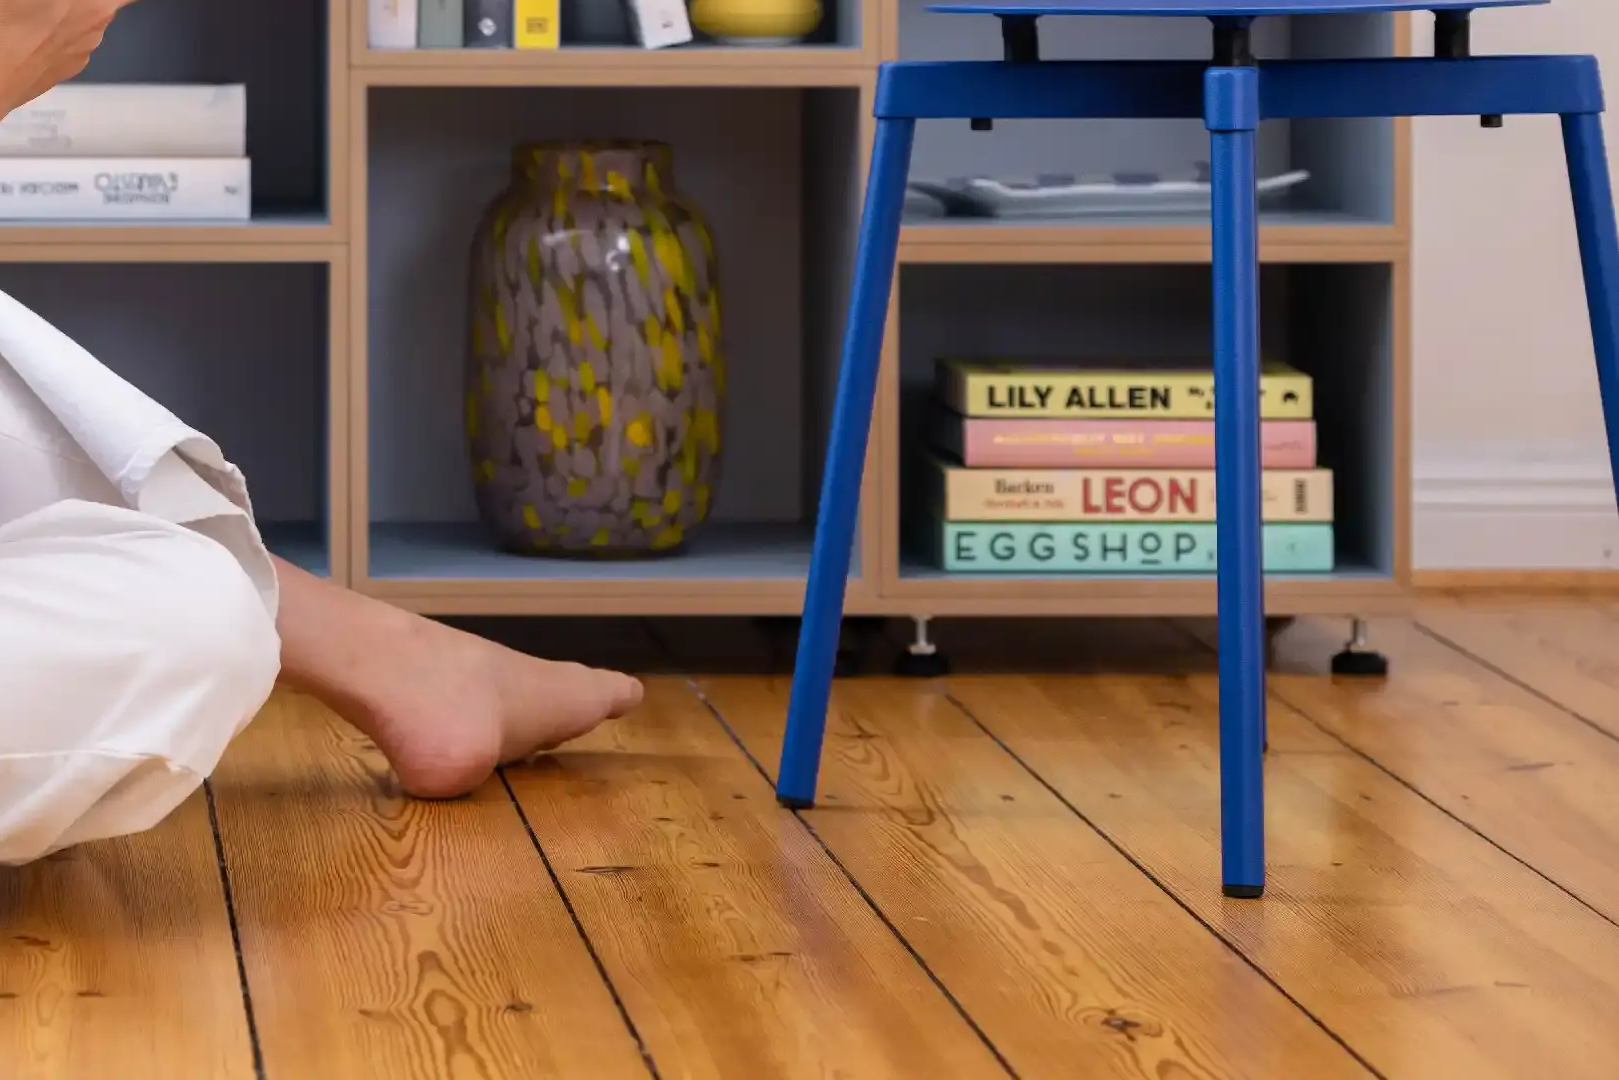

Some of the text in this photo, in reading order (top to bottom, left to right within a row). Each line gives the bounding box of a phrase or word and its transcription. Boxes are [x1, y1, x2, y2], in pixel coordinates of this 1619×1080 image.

[987, 385, 1052, 409] LILY
[1065, 385, 1171, 410] ALLEN
[1081, 477, 1198, 514] LEON
[955, 531, 1197, 564] EGG SHOP
